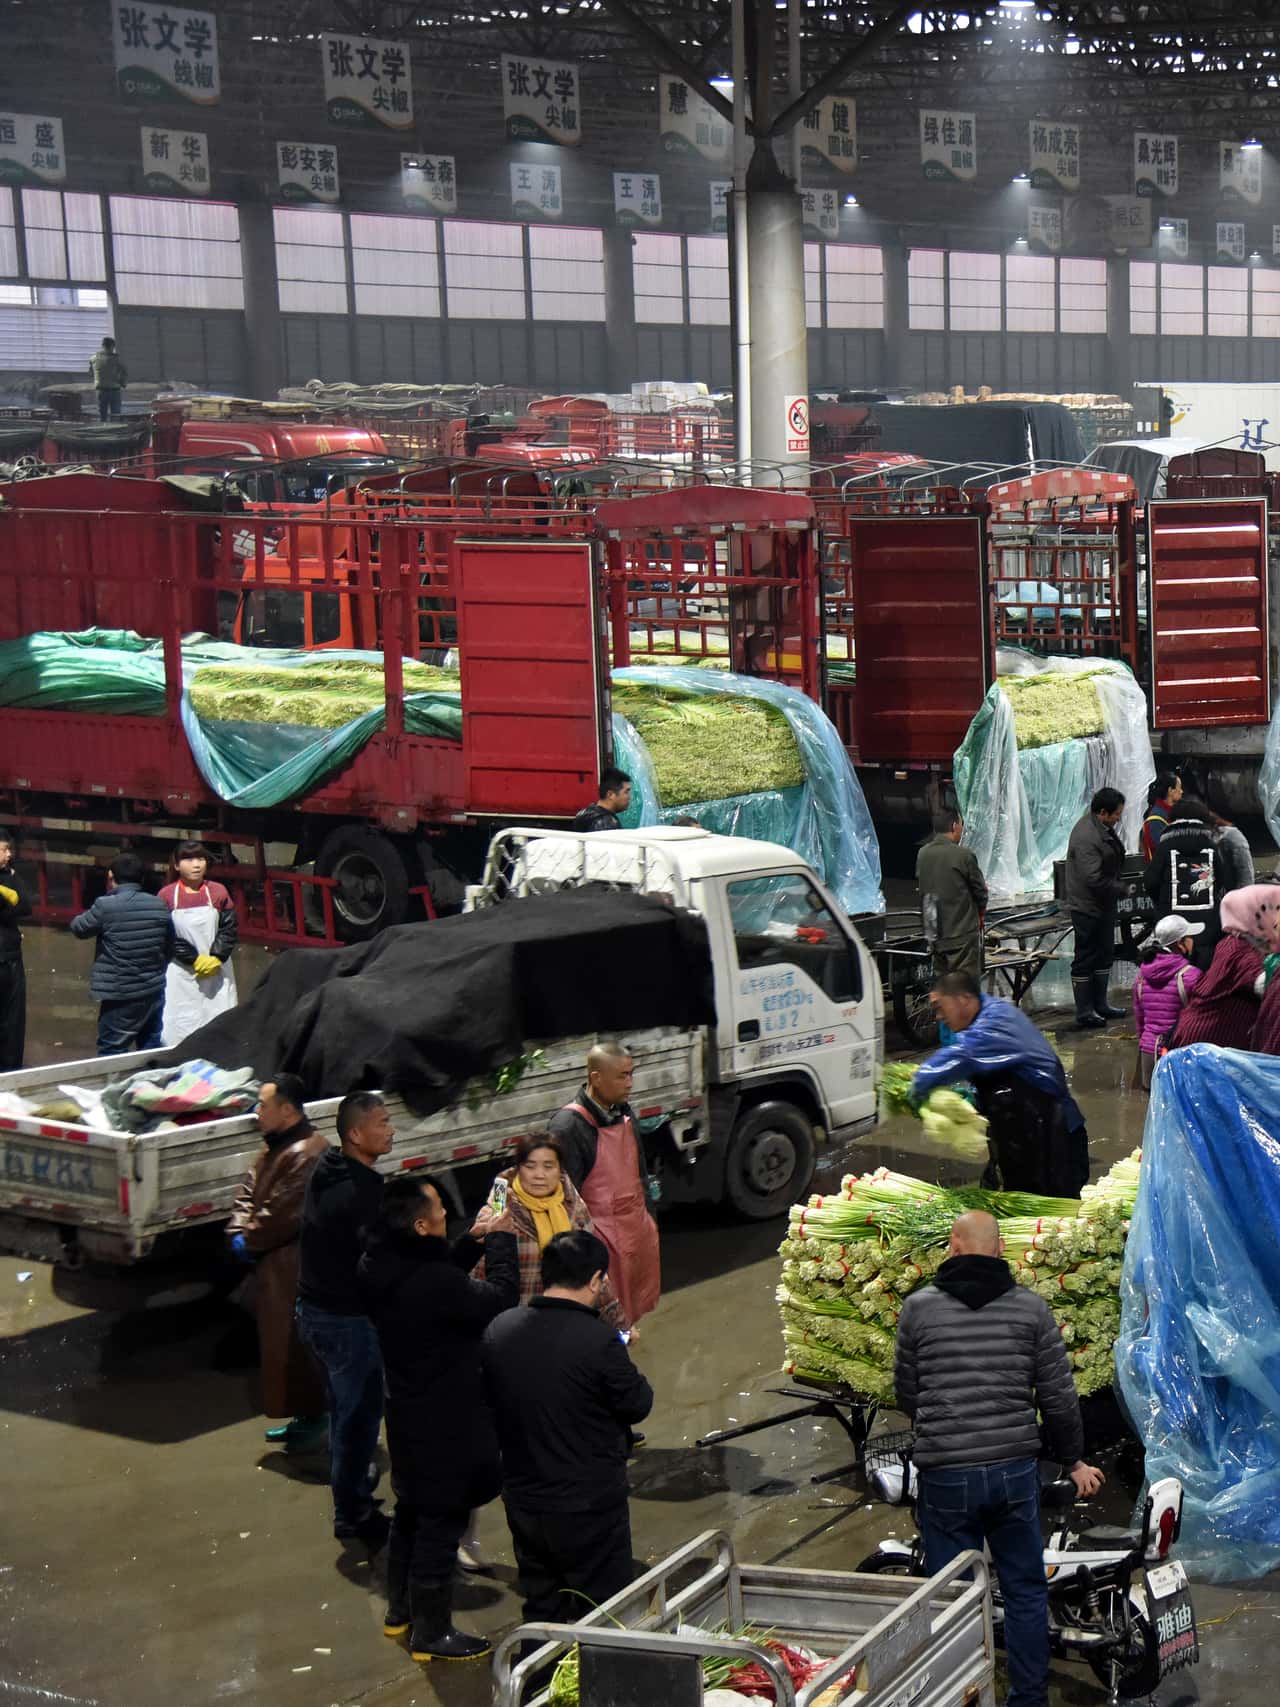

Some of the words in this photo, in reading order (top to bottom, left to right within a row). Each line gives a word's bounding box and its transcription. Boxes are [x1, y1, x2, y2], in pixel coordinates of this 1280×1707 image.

[119, 7, 213, 58] 张文学
[328, 40, 406, 85] 张文学
[507, 61, 575, 104] 张文学
[372, 87, 410, 113] 尖椒
[544, 105, 577, 130] 尖椒
[923, 115, 973, 148] 绿佳源
[31, 151, 60, 170] 尖椒
[150, 133, 202, 161] 新华
[281, 147, 336, 173] 彭安家
[1137, 138, 1177, 166] 桑光辉
[311, 173, 336, 193] 尖椒
[516, 168, 557, 193] 王涛
[620, 178, 656, 199] 王涛
[1157, 1603, 1192, 1643] 雅迪
